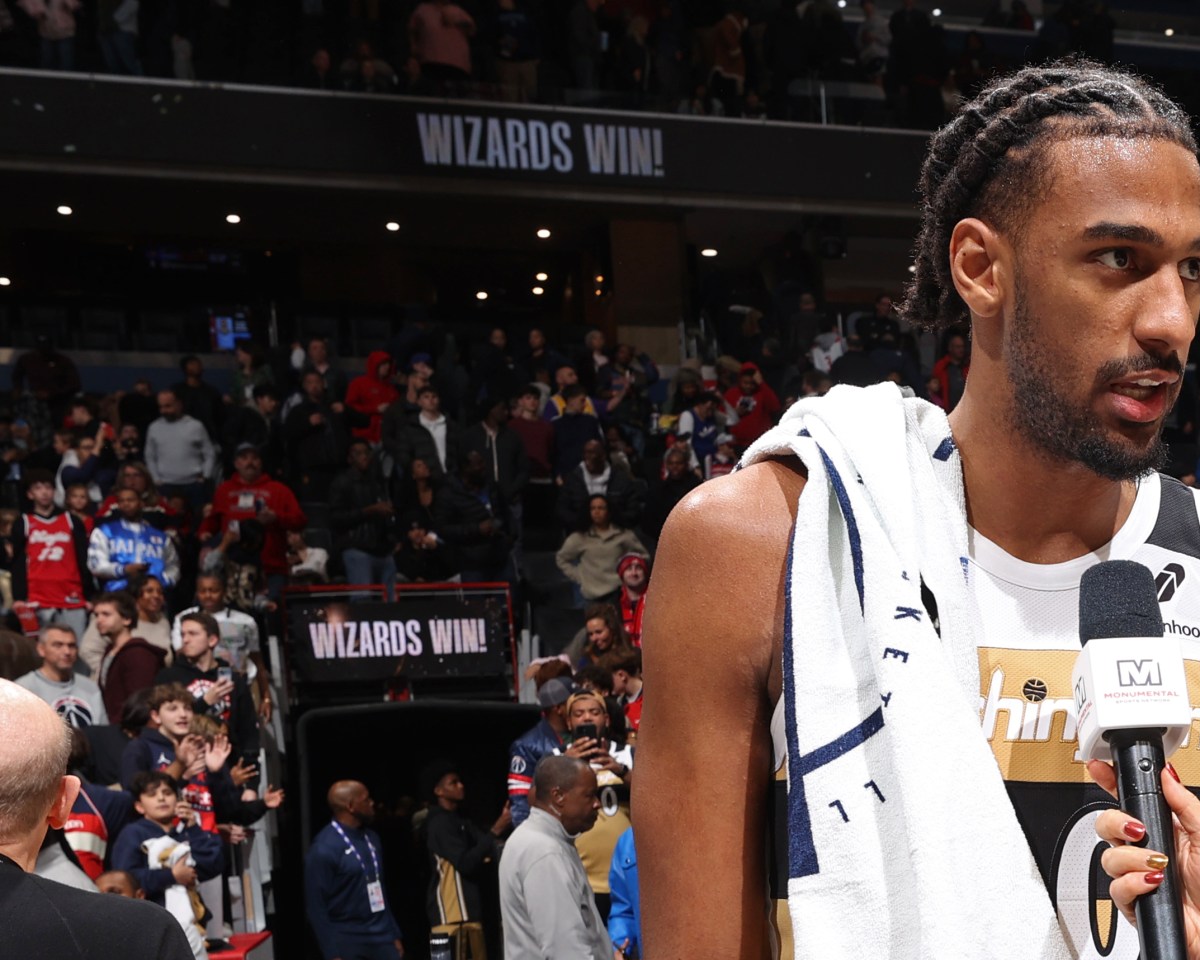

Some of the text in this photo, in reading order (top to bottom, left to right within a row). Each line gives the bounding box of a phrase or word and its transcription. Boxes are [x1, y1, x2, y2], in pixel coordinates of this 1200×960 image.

[417, 113, 664, 177] WIZARDS WIN!
[309, 618, 487, 659] WIZARDS WIN!
[1104, 690, 1180, 699] MONUMENTAL
